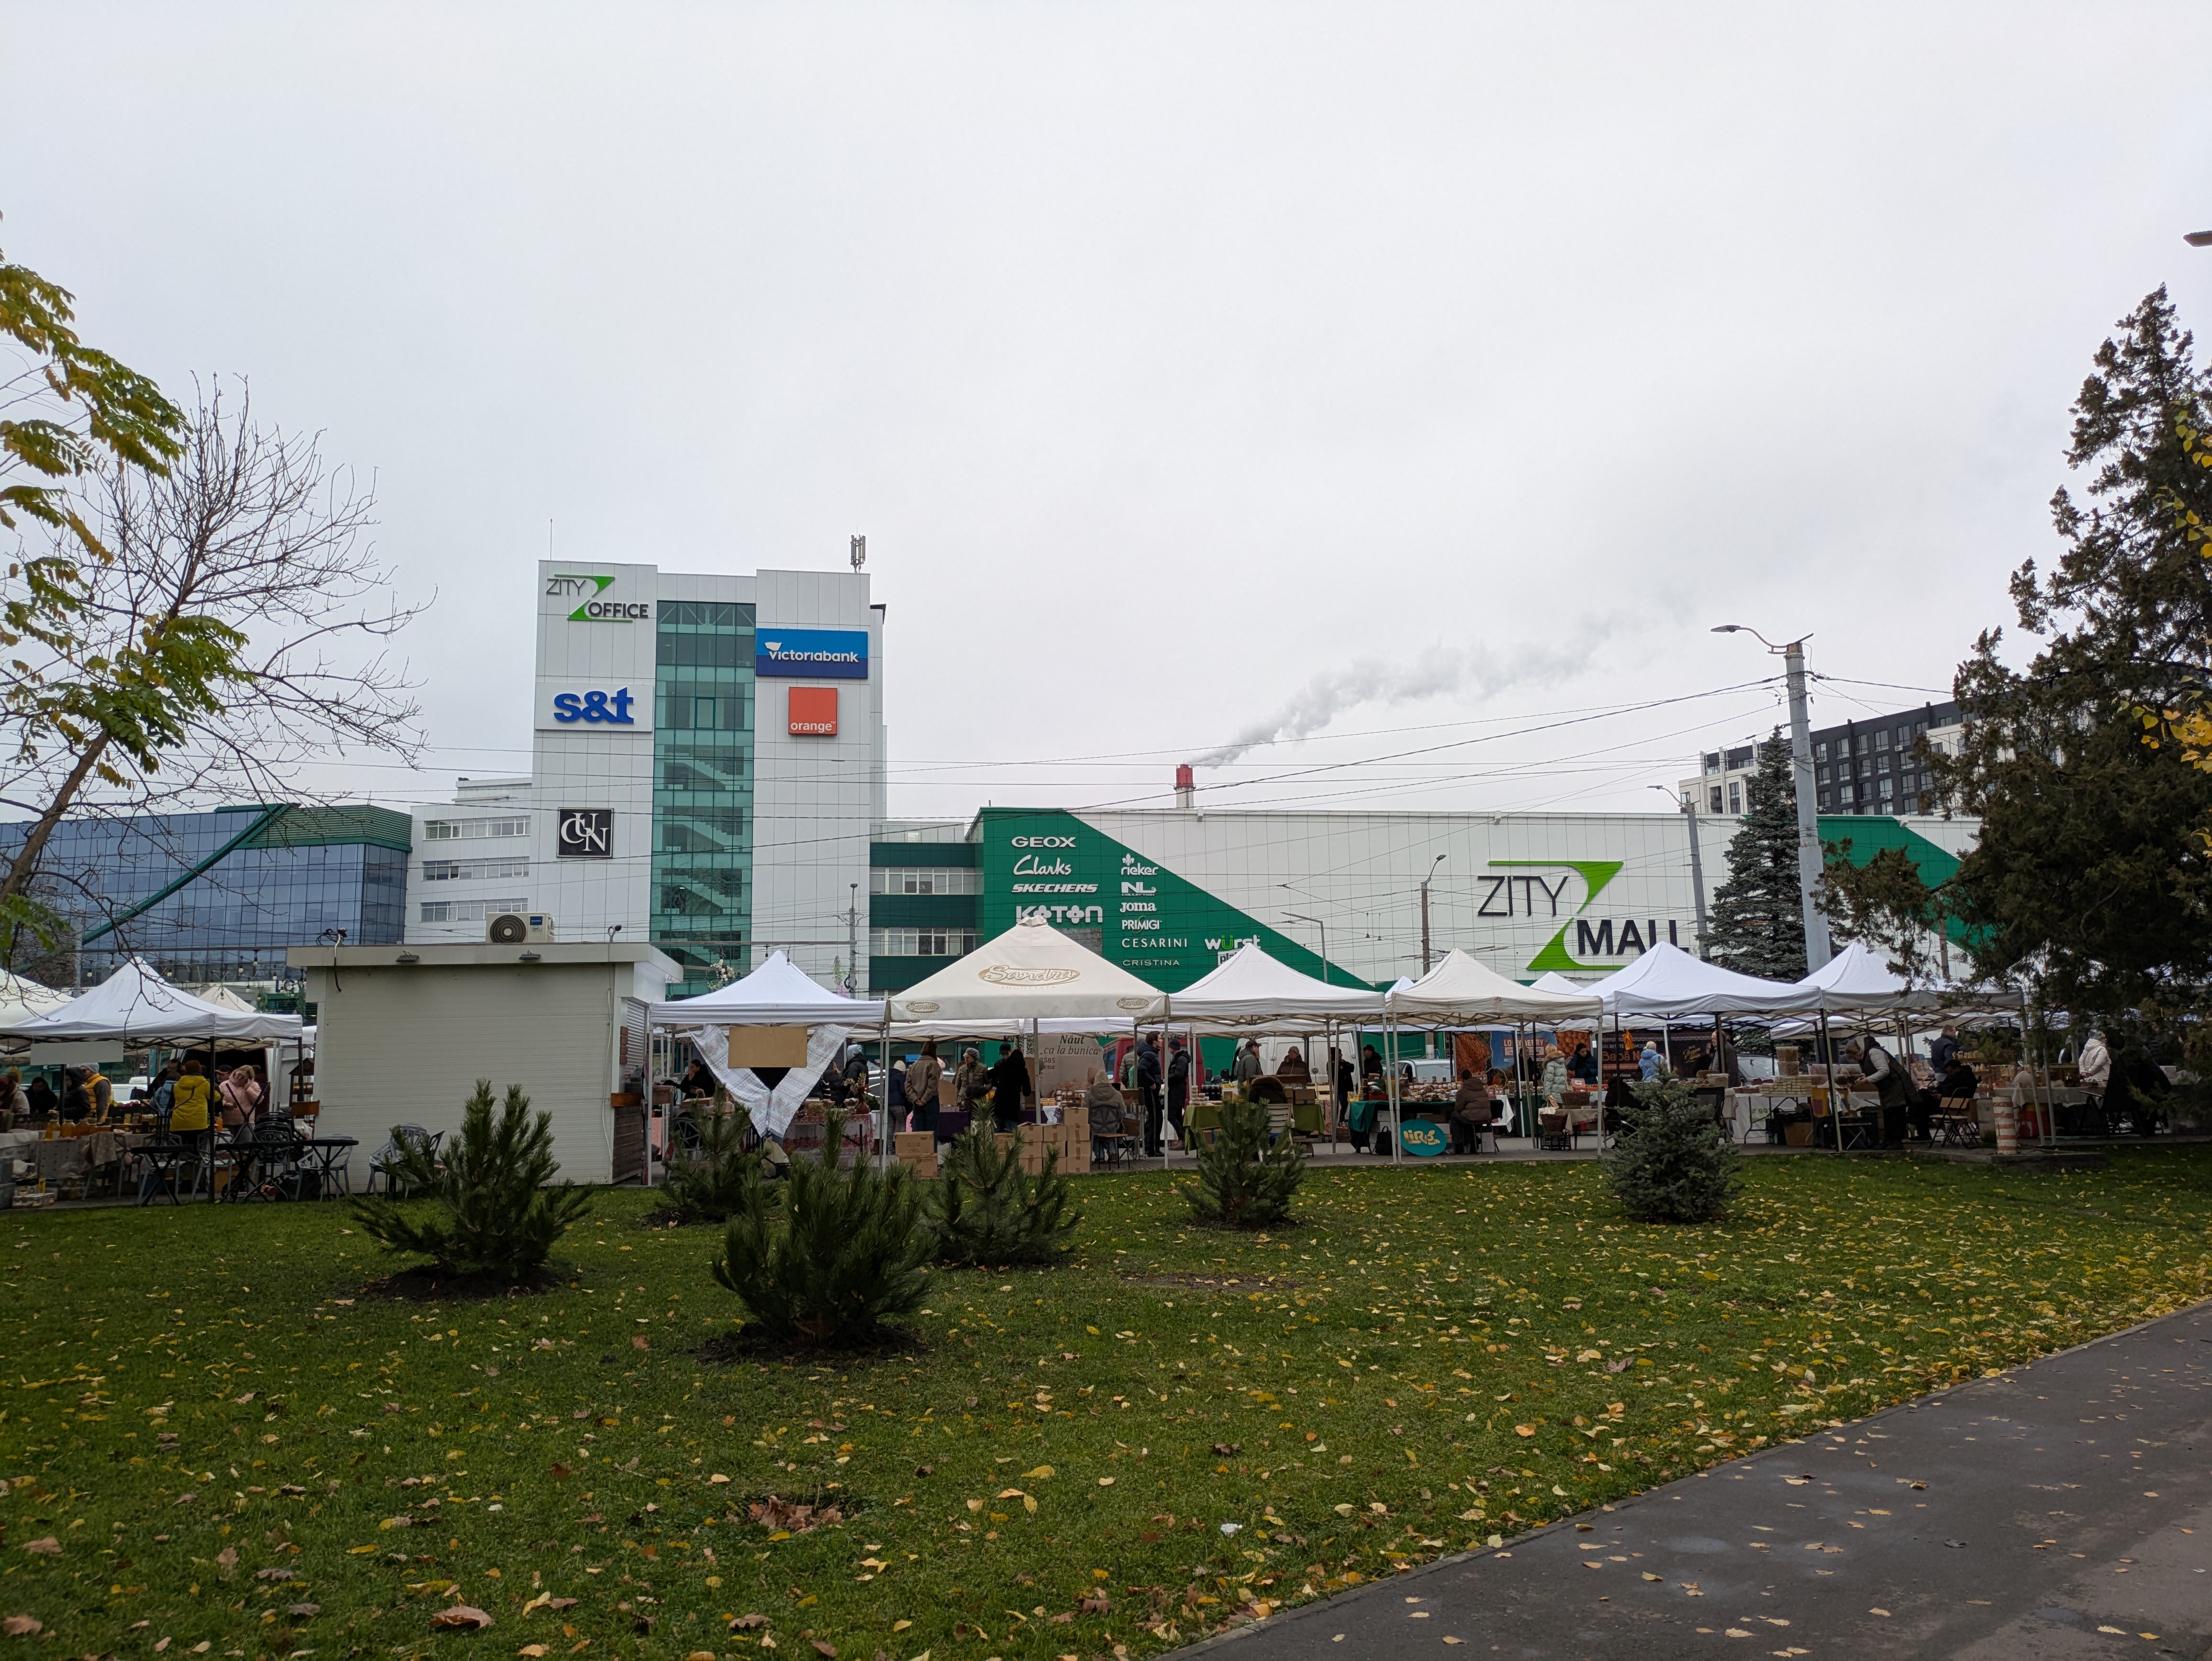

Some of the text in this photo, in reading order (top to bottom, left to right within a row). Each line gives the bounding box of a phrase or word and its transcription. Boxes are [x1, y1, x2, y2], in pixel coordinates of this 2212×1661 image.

[546, 578, 586, 596] ZITY
[588, 602, 649, 619] OFFICE
[1011, 836, 1076, 848] GEOX
[1013, 854, 1072, 875] Clarks
[1121, 863, 1159, 876] rieker
[1011, 884, 1099, 893] SKECHERS
[1477, 876, 1569, 917] ZITY
[1121, 919, 1160, 930] PRIMIGI
[1122, 938, 1187, 948] CESARINI
[1577, 919, 1689, 955] MALL
[983, 964, 1074, 981] Sandra
[908, 1001, 937, 1010] Sandra
[1118, 997, 1148, 1007] Sandra
[1060, 1035, 1085, 1044] Năut
[1057, 1045, 1065, 1054] la
